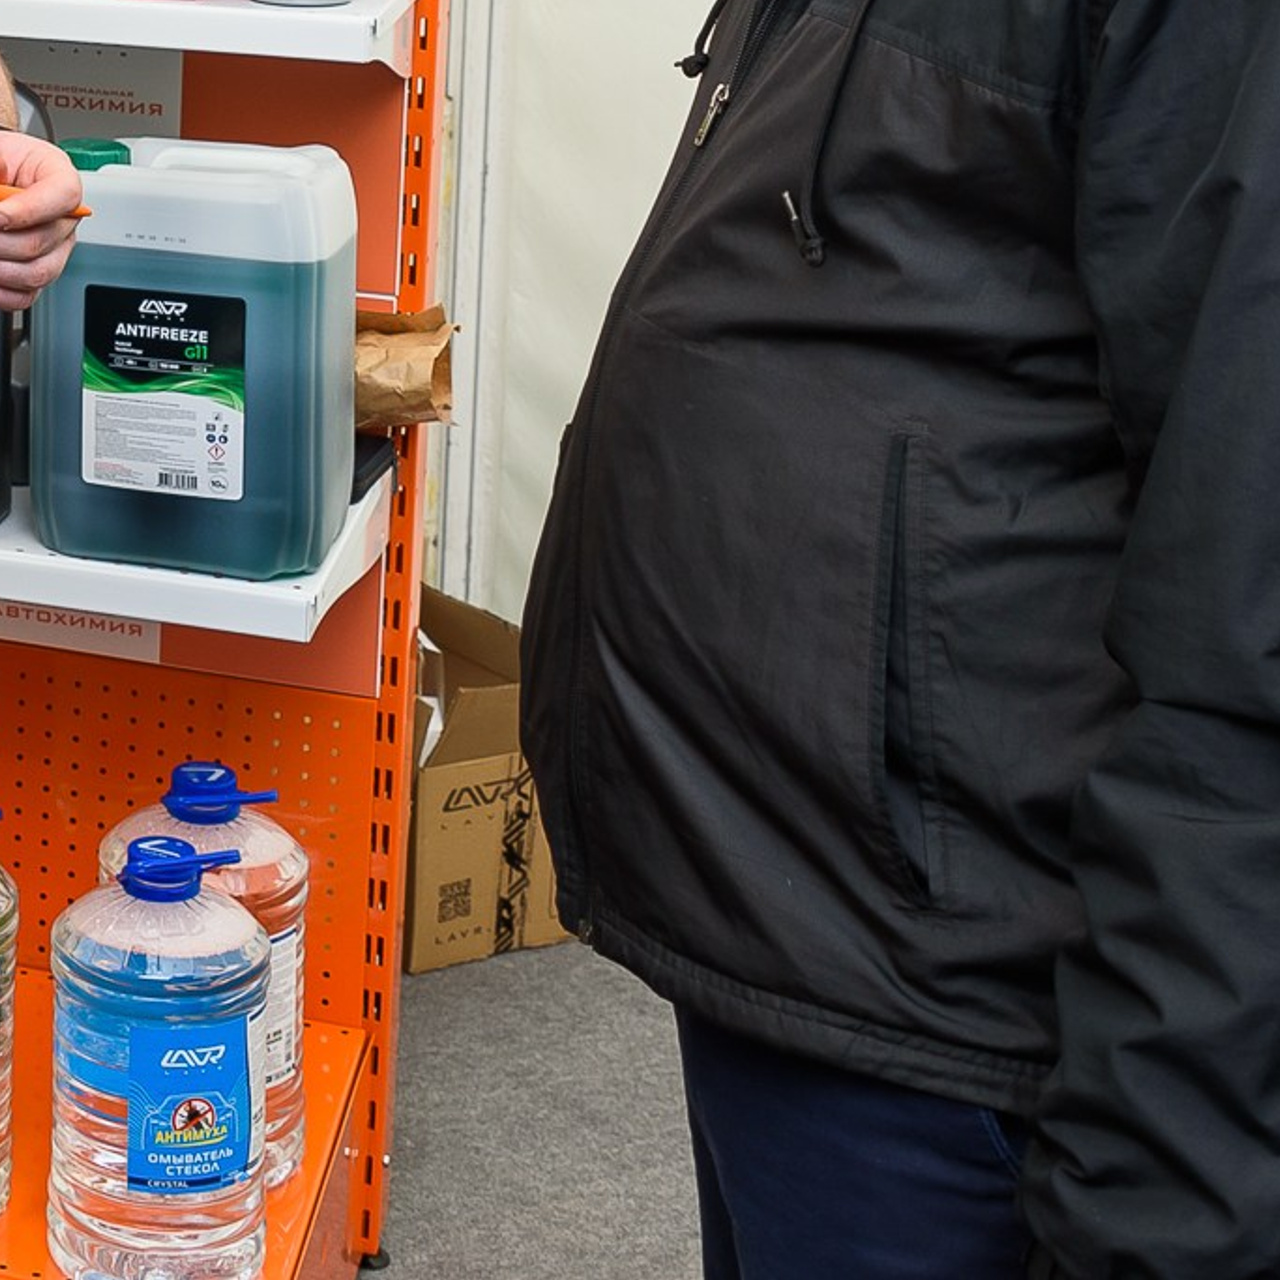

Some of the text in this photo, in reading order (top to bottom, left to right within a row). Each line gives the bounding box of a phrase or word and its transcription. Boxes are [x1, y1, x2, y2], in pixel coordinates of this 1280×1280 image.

[138, 299, 188, 316] LAVR
[114, 322, 209, 344] ANTIFREEZE
[184, 345, 208, 360] G11
[161, 1045, 226, 1067] LAVR
[154, 1124, 228, 1144] АНТИМУХА
[148, 1147, 233, 1165] ОМЫВАТЕЛЬ
[166, 1162, 220, 1176] СТЕКОЛ
